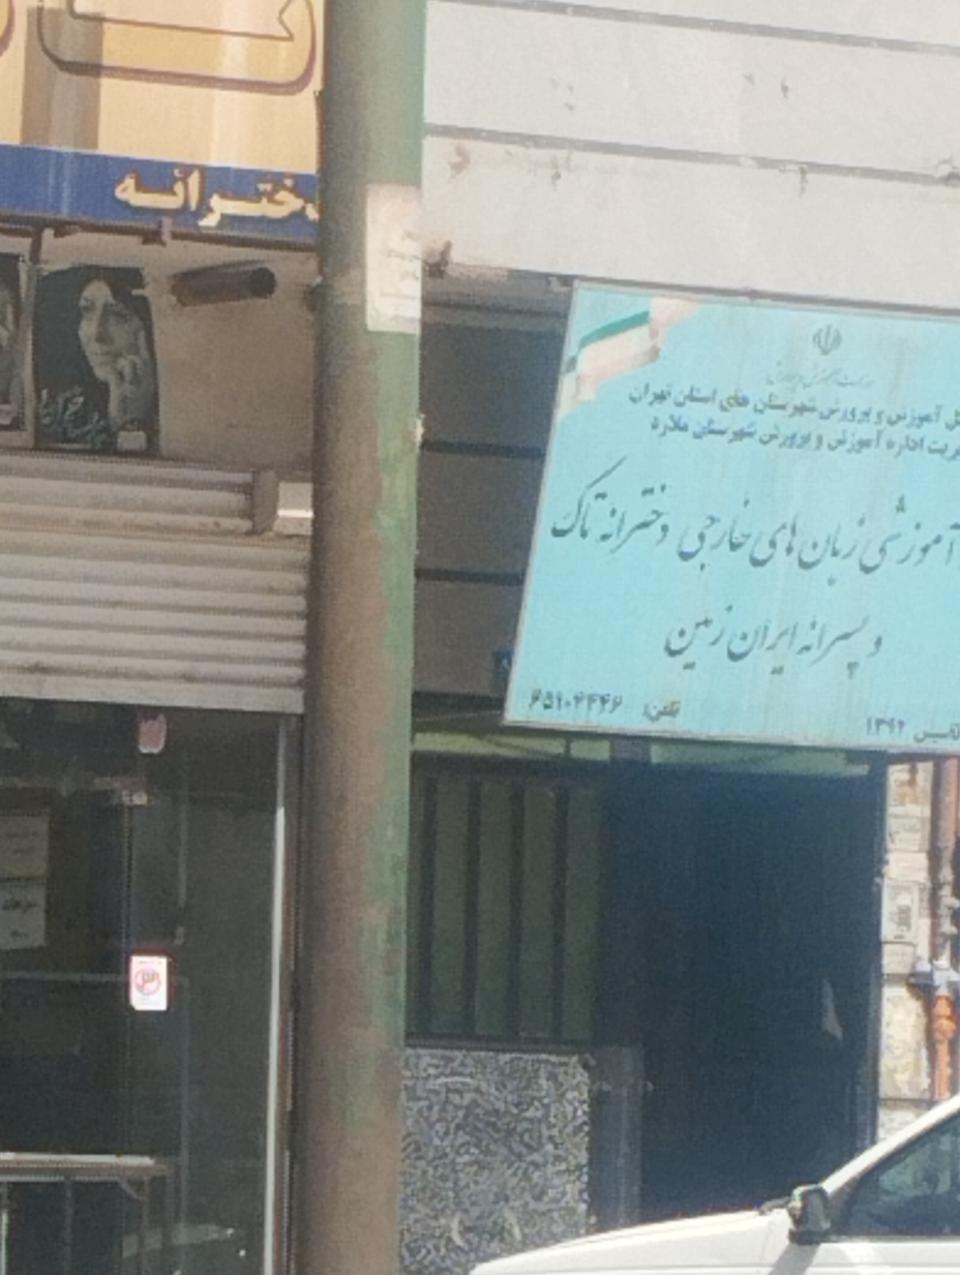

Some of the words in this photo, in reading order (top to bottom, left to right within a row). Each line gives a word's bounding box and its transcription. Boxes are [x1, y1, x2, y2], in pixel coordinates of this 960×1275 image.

[677, 496, 753, 572] خارجی
[749, 512, 801, 568] های
[797, 512, 866, 587] زبان
[663, 604, 734, 671] زمین
[726, 618, 800, 676] ایران
[796, 614, 871, 680] پسرانه
